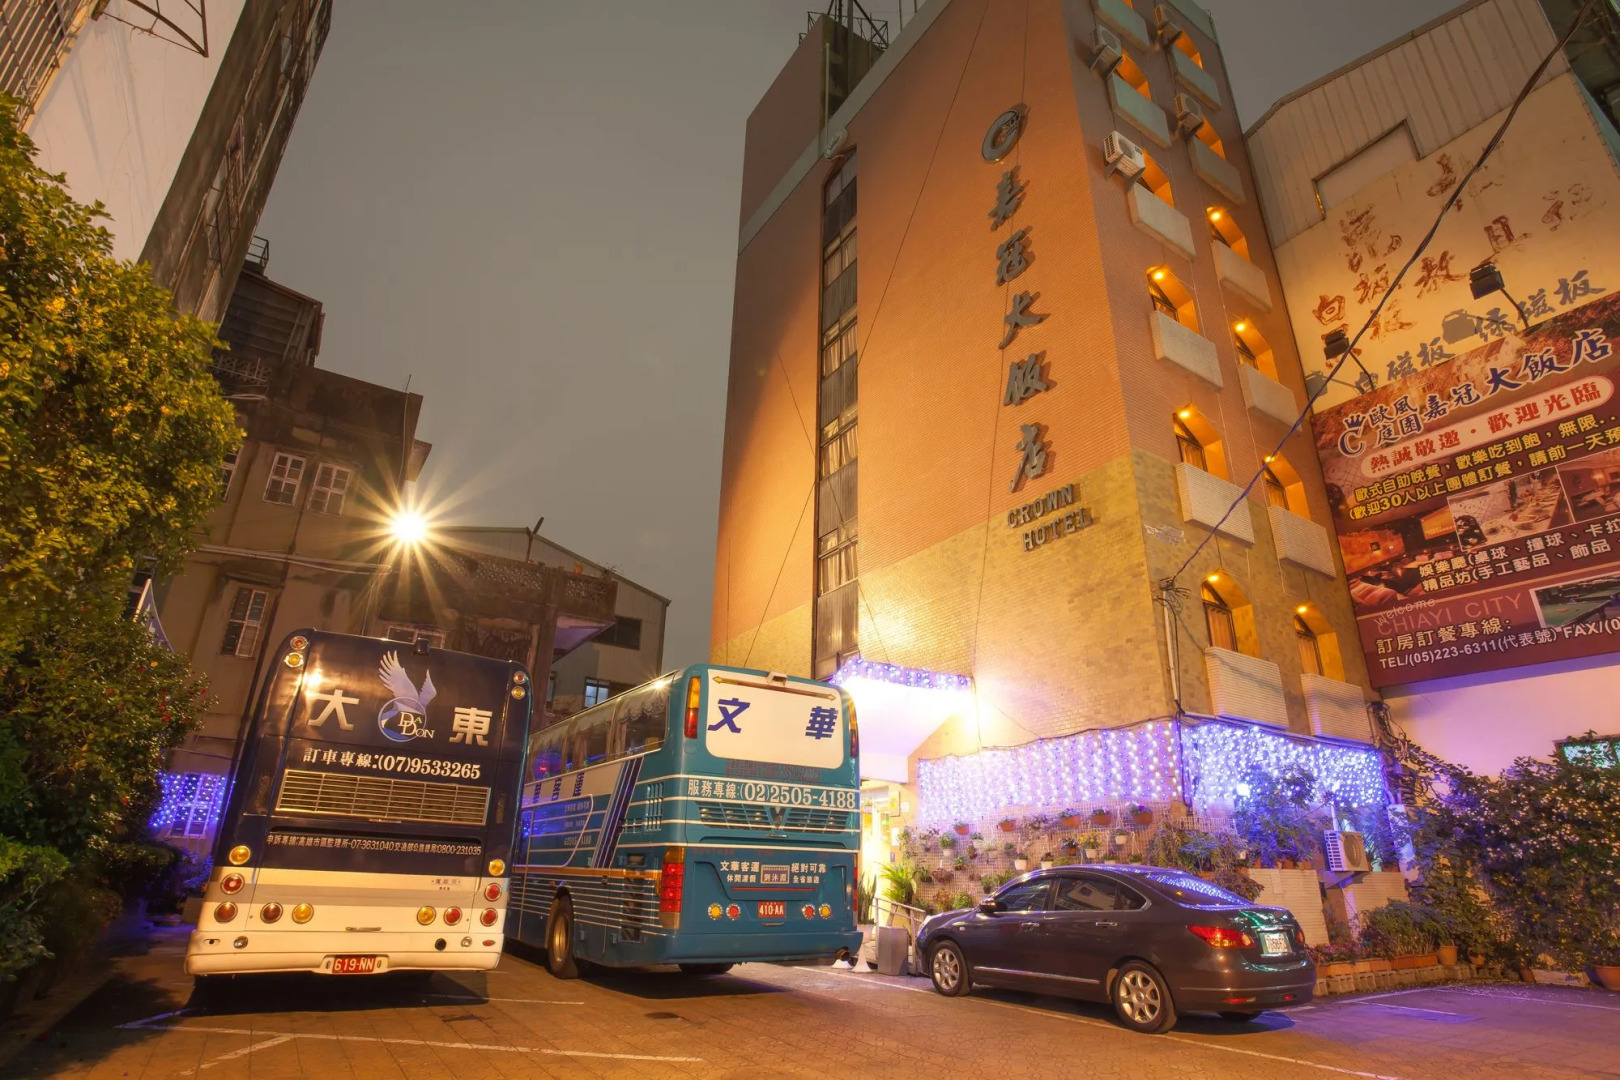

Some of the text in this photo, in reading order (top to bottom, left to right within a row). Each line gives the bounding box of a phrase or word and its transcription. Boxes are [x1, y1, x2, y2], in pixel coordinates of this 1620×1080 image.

[1424, 329, 1613, 423] 嘉冠大飯店
[1007, 483, 1074, 529] CROWN
[1023, 507, 1092, 552] HOTEL
[1377, 592, 1522, 635] CHIAYI CITY
[308, 689, 493, 747] 大 東
[707, 697, 839, 740] 文 華
[334, 957, 375, 971] 619-NN
